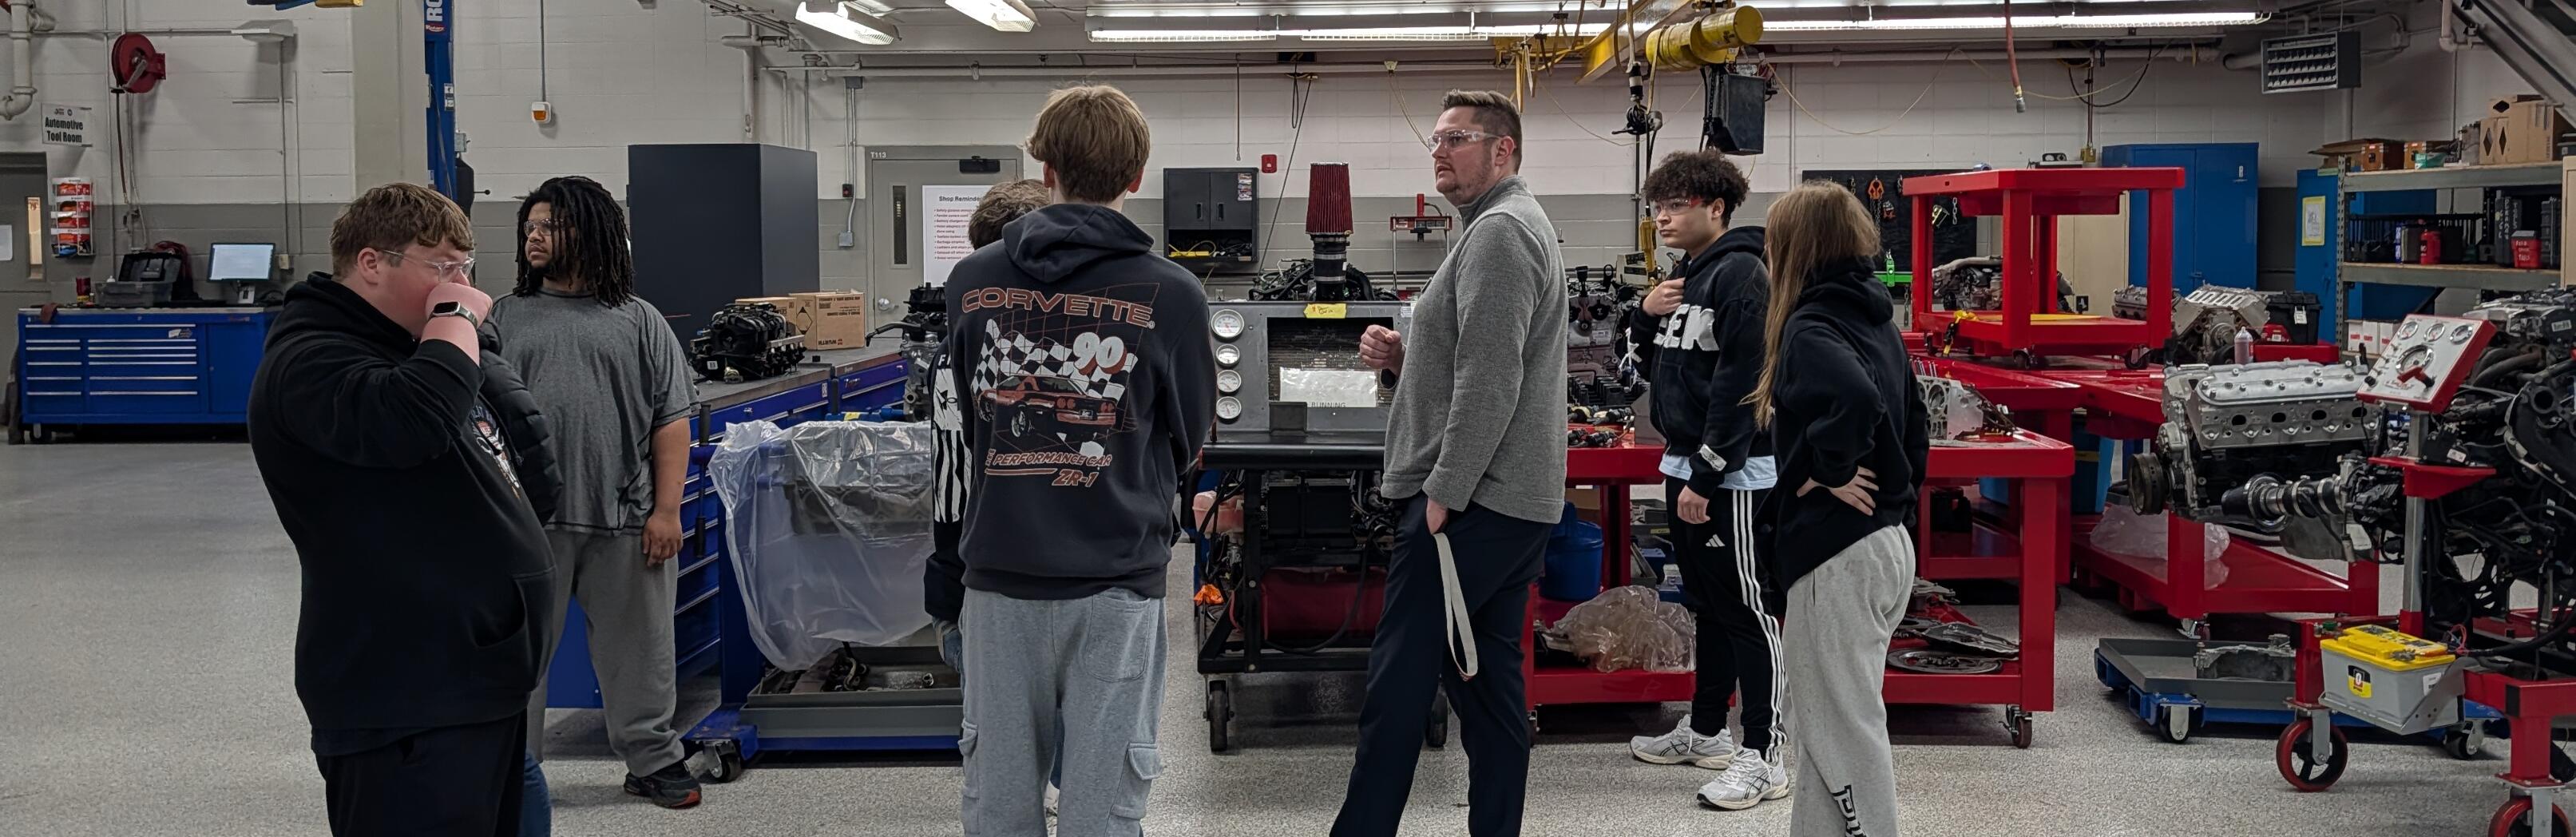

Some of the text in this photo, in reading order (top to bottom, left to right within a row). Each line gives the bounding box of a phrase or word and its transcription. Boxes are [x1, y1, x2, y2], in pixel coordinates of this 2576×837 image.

[45, 117, 84, 130] Automotive
[47, 130, 82, 143] Tool Room
[1073, 332, 1126, 375] 90
[993, 452, 1087, 466] PERFORMANCE
[1086, 454, 1113, 467] CAR
[1052, 469, 1100, 487] ZR-1
